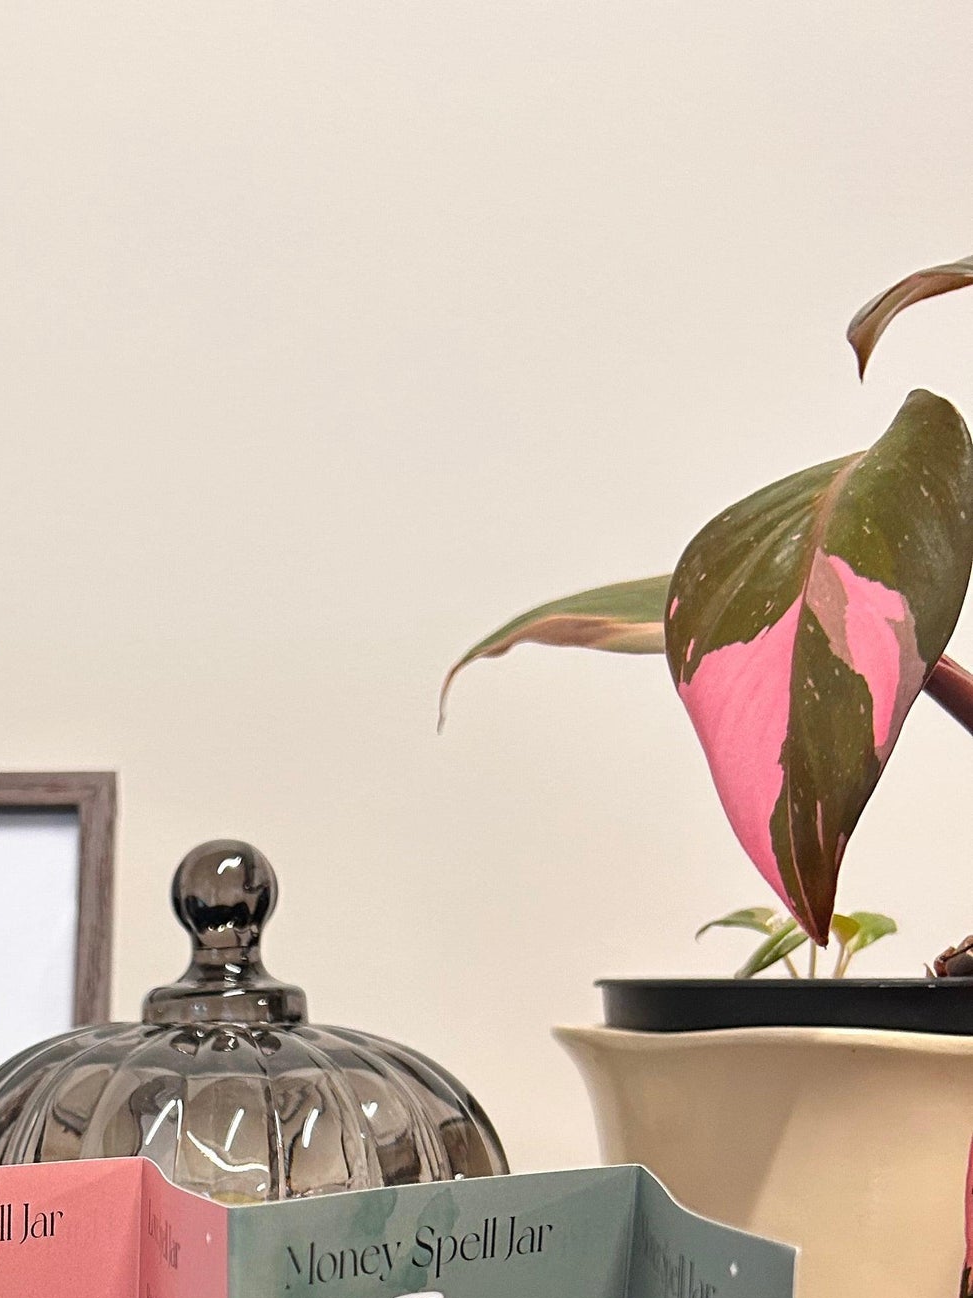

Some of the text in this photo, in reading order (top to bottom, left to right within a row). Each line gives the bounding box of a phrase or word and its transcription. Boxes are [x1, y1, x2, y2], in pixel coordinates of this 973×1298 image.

[20, 1203, 63, 1244] Jar
[285, 1216, 553, 1289] Money Spell Jar
